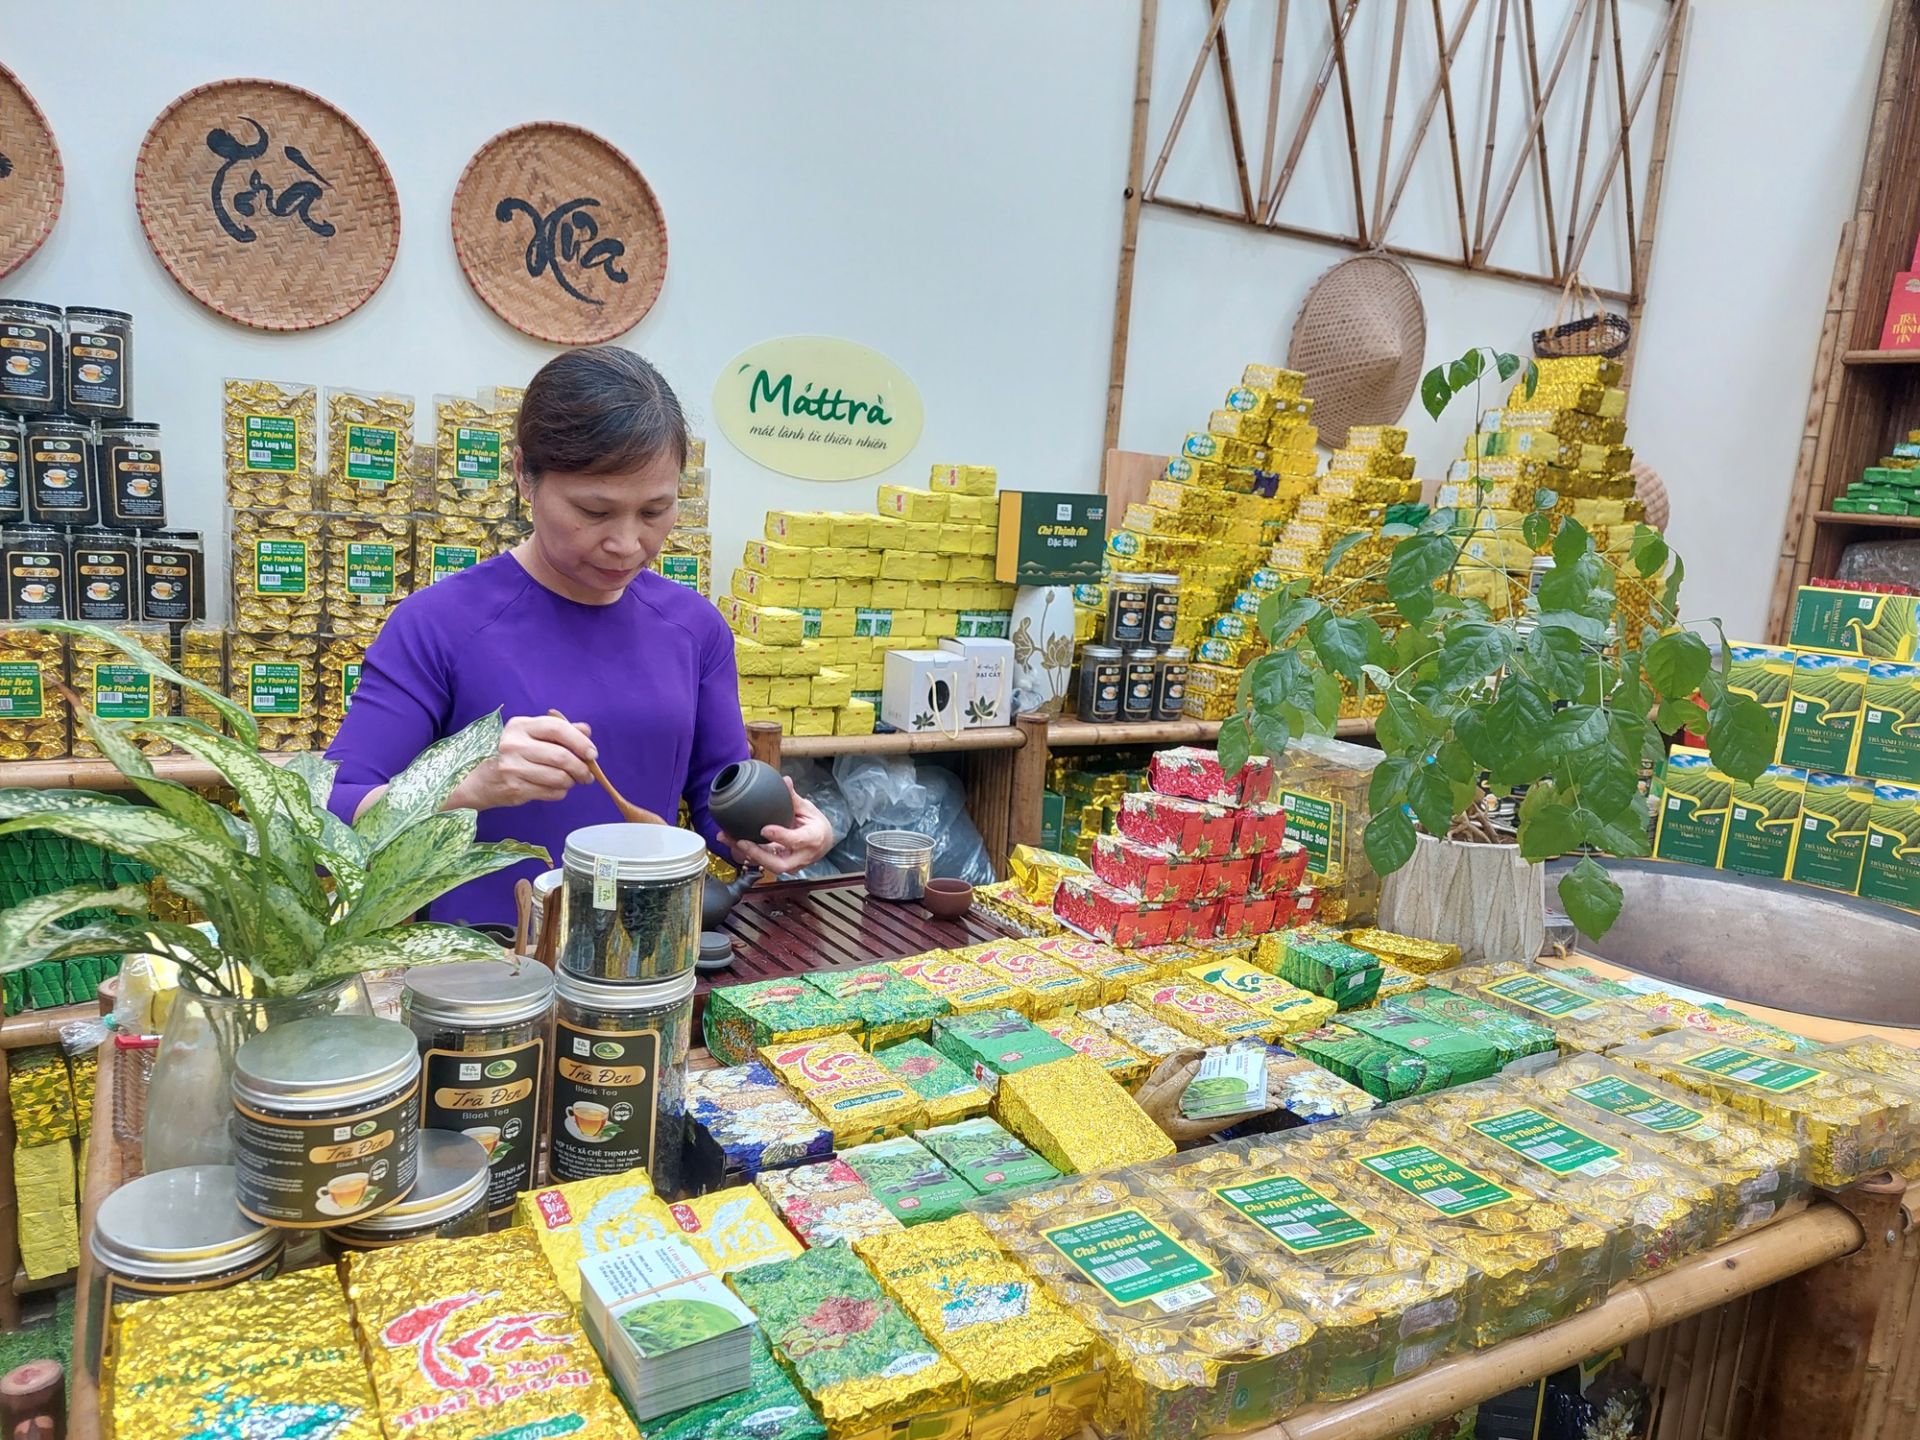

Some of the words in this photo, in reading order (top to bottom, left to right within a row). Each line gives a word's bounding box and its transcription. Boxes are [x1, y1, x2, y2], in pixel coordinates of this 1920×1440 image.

[750, 425, 774, 437] mát
[778, 425, 805, 441] lành
[824, 432, 852, 446] thiên
[856, 436, 888, 450] nhiên
[568, 1063, 593, 1082] Trà
[598, 1068, 632, 1084] Đen
[452, 1091, 484, 1107] Trà
[490, 1088, 522, 1105] Đen
[575, 1085, 598, 1096] Black
[601, 1088, 618, 1097] Tea
[462, 1111, 489, 1120] Black
[494, 1107, 510, 1117] Tea
[325, 1147, 354, 1161] Trà
[565, 1143, 577, 1153] TÁC
[586, 1149, 602, 1157] CHÈ
[604, 1150, 627, 1158] THỊNH
[1244, 1202, 1266, 1213] Chè
[1266, 1195, 1301, 1209] Thịnh
[1302, 1192, 1318, 1201] An
[1291, 1206, 1317, 1219] Bắc
[1072, 1243, 1098, 1259] Chè
[1098, 1235, 1137, 1250] Thịnh
[1138, 1229, 1158, 1241] An
